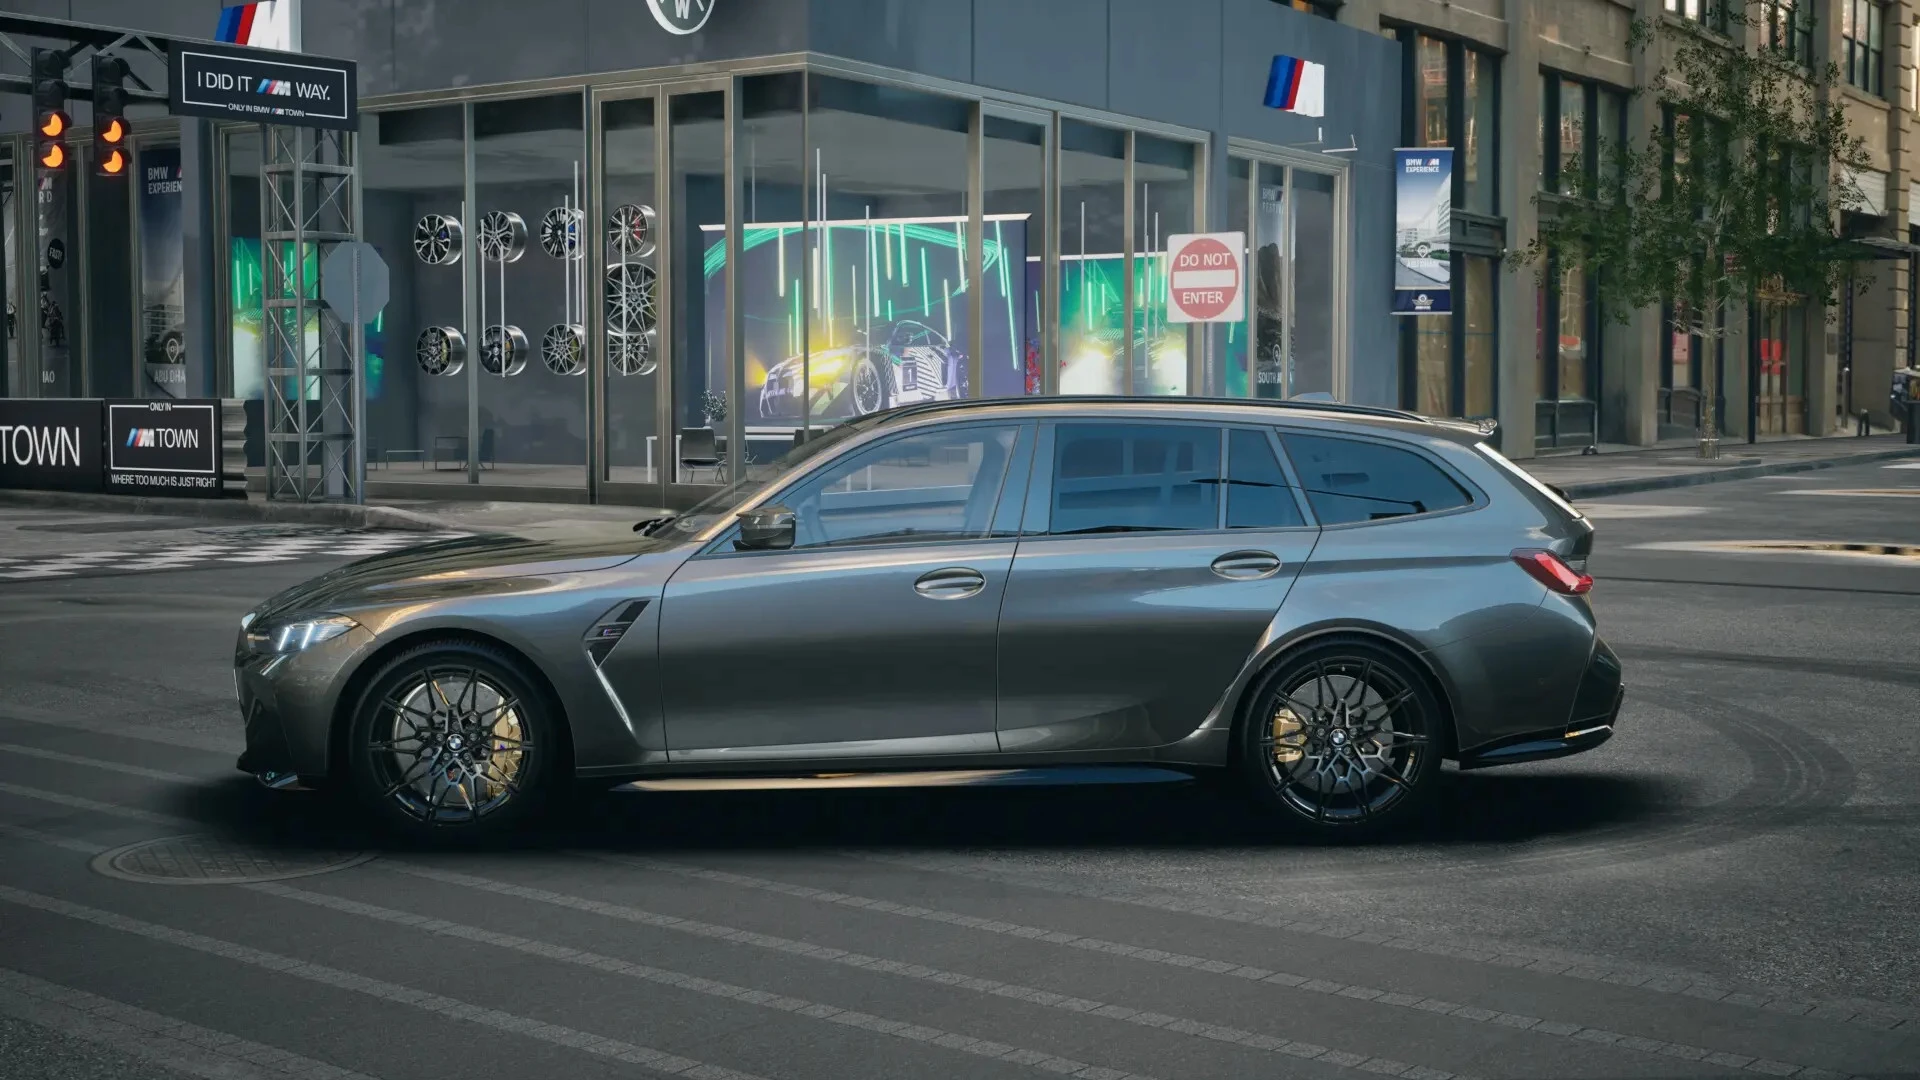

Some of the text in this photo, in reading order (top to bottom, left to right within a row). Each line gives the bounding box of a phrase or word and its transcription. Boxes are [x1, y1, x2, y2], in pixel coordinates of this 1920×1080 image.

[198, 71, 201, 87] I
[205, 72, 234, 91] DID
[238, 76, 253, 92] IT
[296, 82, 331, 101] WAY.
[228, 103, 245, 111] ONLY
[253, 106, 270, 114] BMW
[285, 109, 305, 117] TOWN
[1405, 158, 1423, 166] BMW
[147, 166, 169, 181] BMW
[148, 181, 183, 195] EXPERIEN
[1180, 252, 1231, 267] DO NOT
[1182, 291, 1225, 304] ENTER
[154, 369, 187, 384] ABU DHA
[1257, 371, 1276, 384] SOUTH
[150, 402, 172, 411] ONLY IN
[156, 428, 199, 449] TOWN
[0, 425, 81, 467] TOWN
[111, 474, 217, 488] WHERE TOO MUCH IS JUST RIGHT
